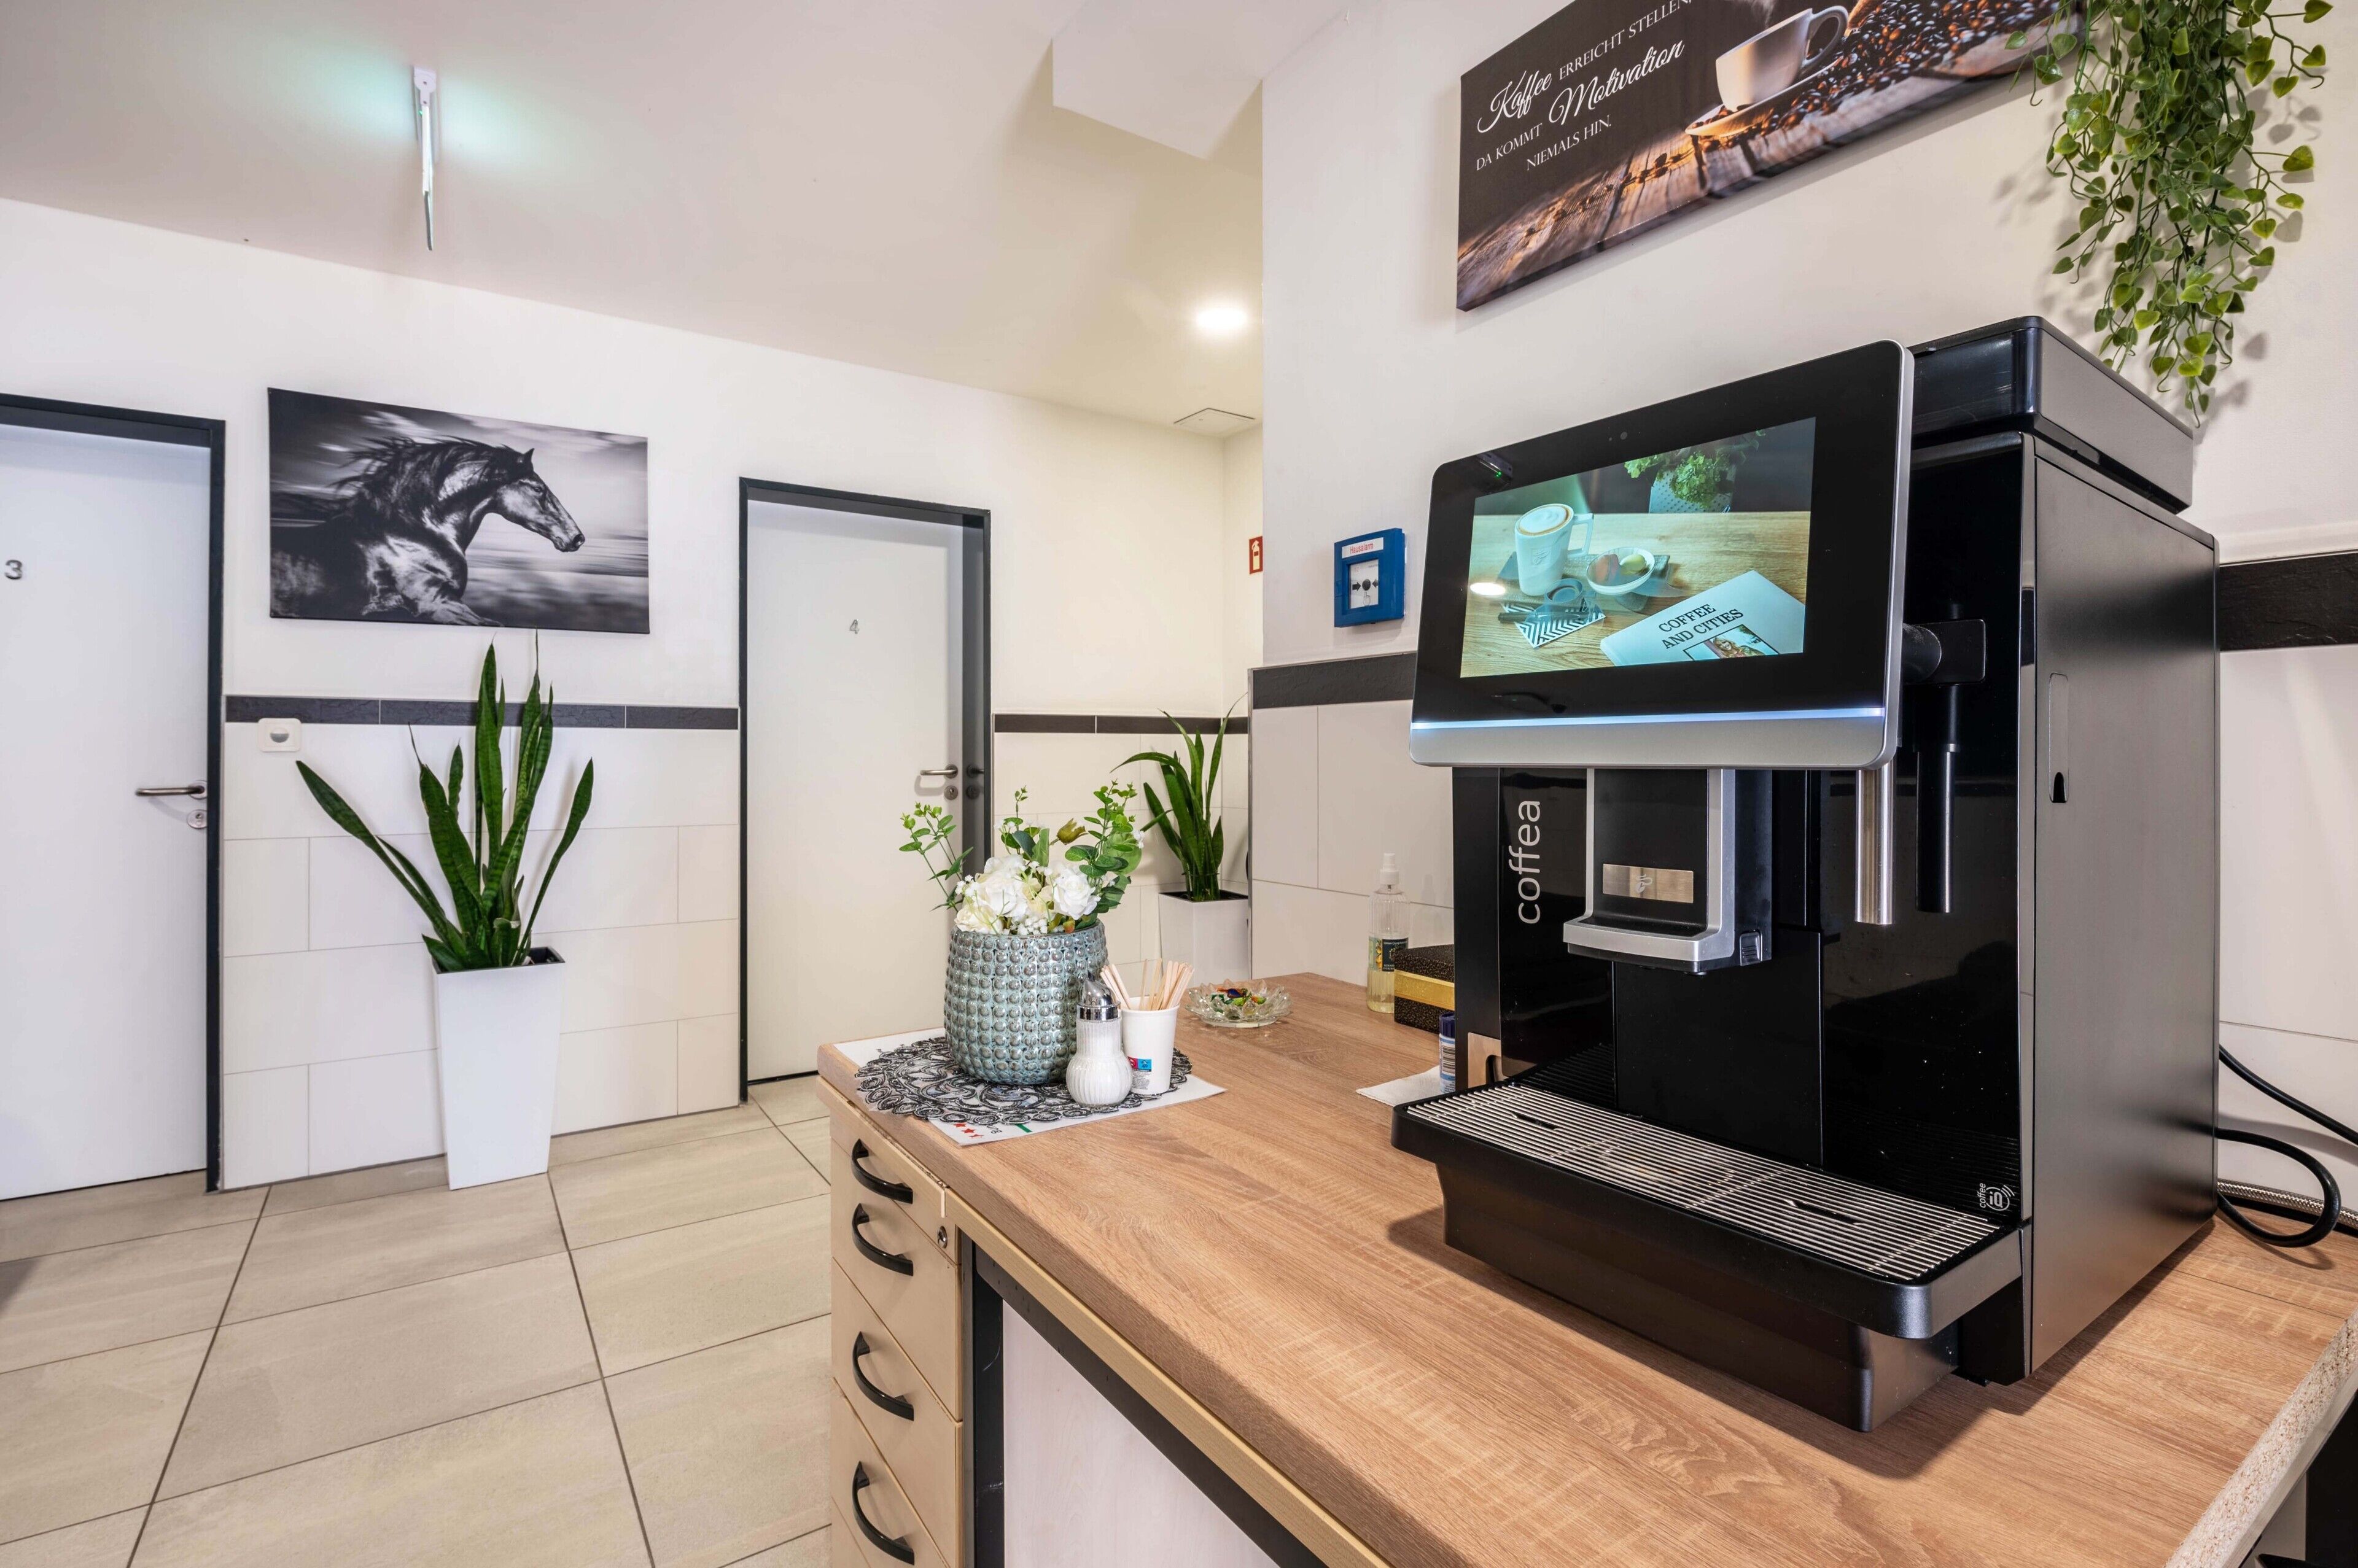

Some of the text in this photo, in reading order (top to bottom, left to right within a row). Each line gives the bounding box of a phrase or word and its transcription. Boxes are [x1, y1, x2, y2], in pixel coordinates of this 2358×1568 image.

[1477, 70, 1552, 133] Kaffee
[1558, 29, 1625, 81] ERREICHT
[1476, 39, 1685, 171] DA KOMMT Motivation
[1526, 114, 1612, 171] NIEMALS HIN.
[1350, 543, 1374, 554] Hausalarm
[4, 559, 23, 580] 3
[849, 619, 860, 635] 4
[1659, 604, 1716, 632] COFFEE
[1662, 608, 1744, 649] AND CITIES
[1508, 800, 1541, 924] coffea
[1977, 1182, 1986, 1208] coffee
[1990, 1191, 2003, 1208] iQ
